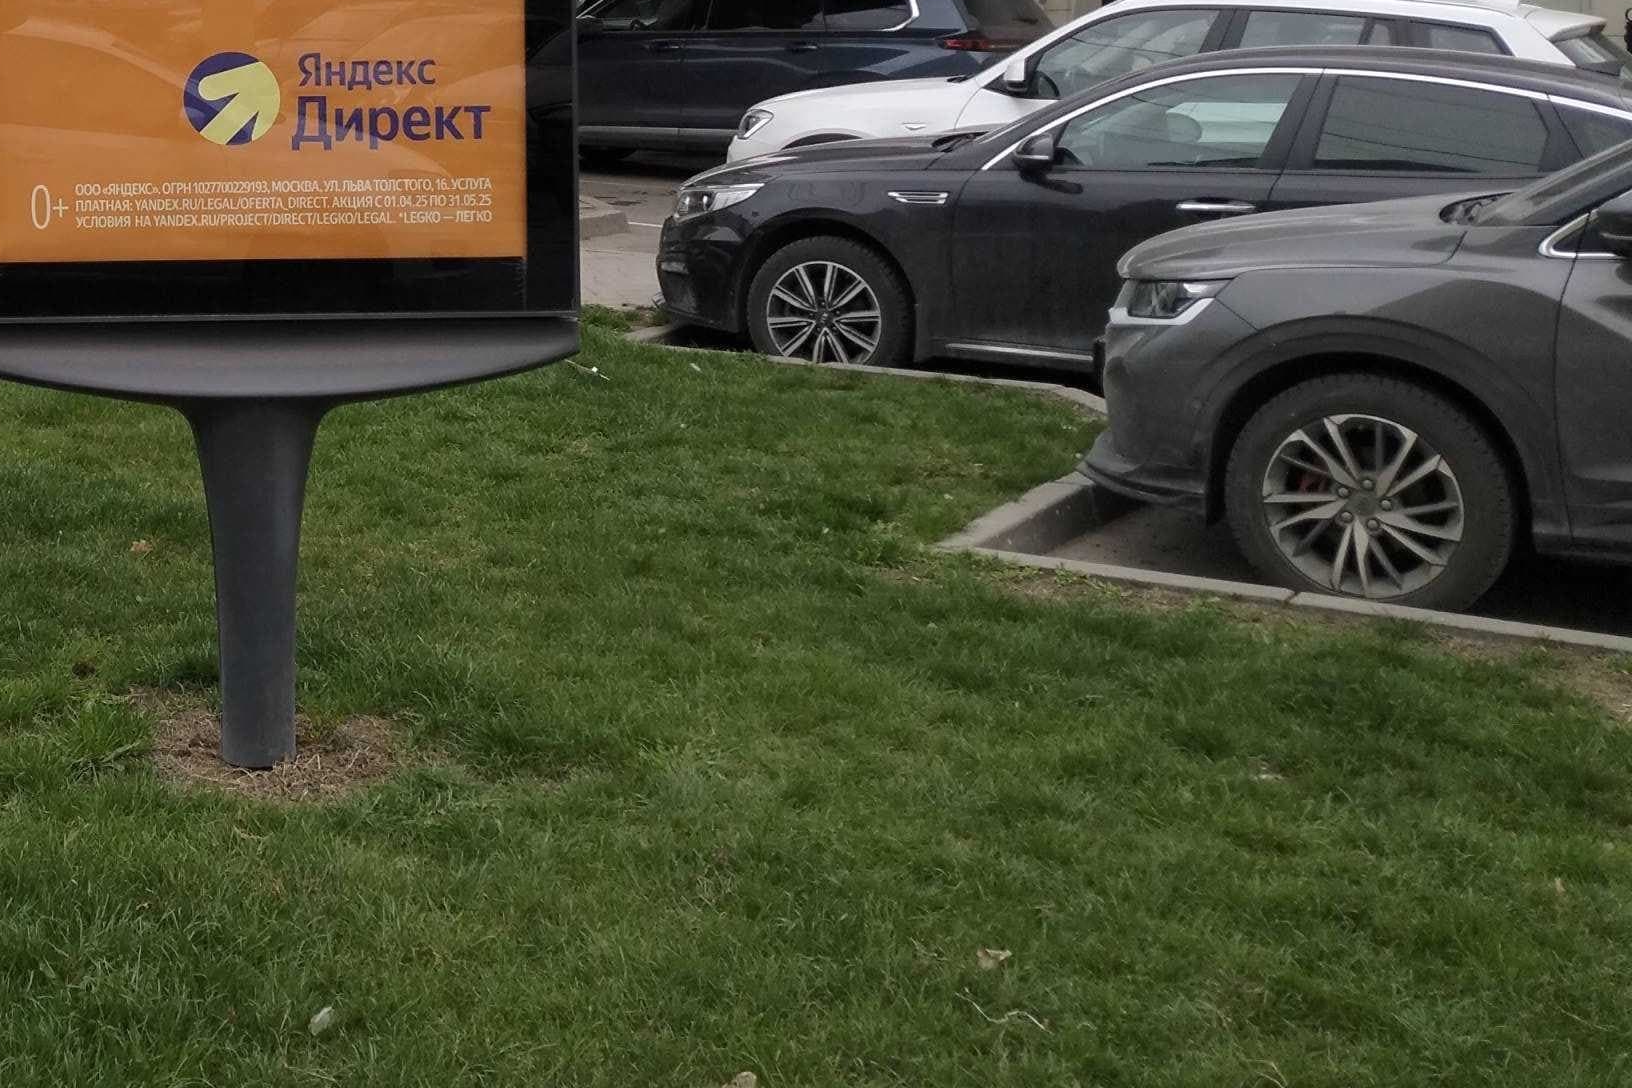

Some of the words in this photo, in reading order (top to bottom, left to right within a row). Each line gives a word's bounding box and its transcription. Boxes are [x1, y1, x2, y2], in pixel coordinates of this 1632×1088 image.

[297, 53, 436, 91] Яндекс
[291, 93, 492, 151] Директ
[75, 183, 101, 196] ООО
[162, 182, 192, 195] ОГРН
[342, 179, 373, 192] ЛЬВА
[451, 177, 492, 191] УСЛУГА
[30, 184, 70, 231] 0+
[75, 199, 133, 212] ПЛАТНАЯ:
[332, 195, 373, 210] АКЦИЯ
[429, 194, 447, 207] ПО
[75, 215, 131, 229] УСЛОВИЯ
[135, 215, 152, 227] НА
[455, 210, 492, 223] ЛЕГКО
